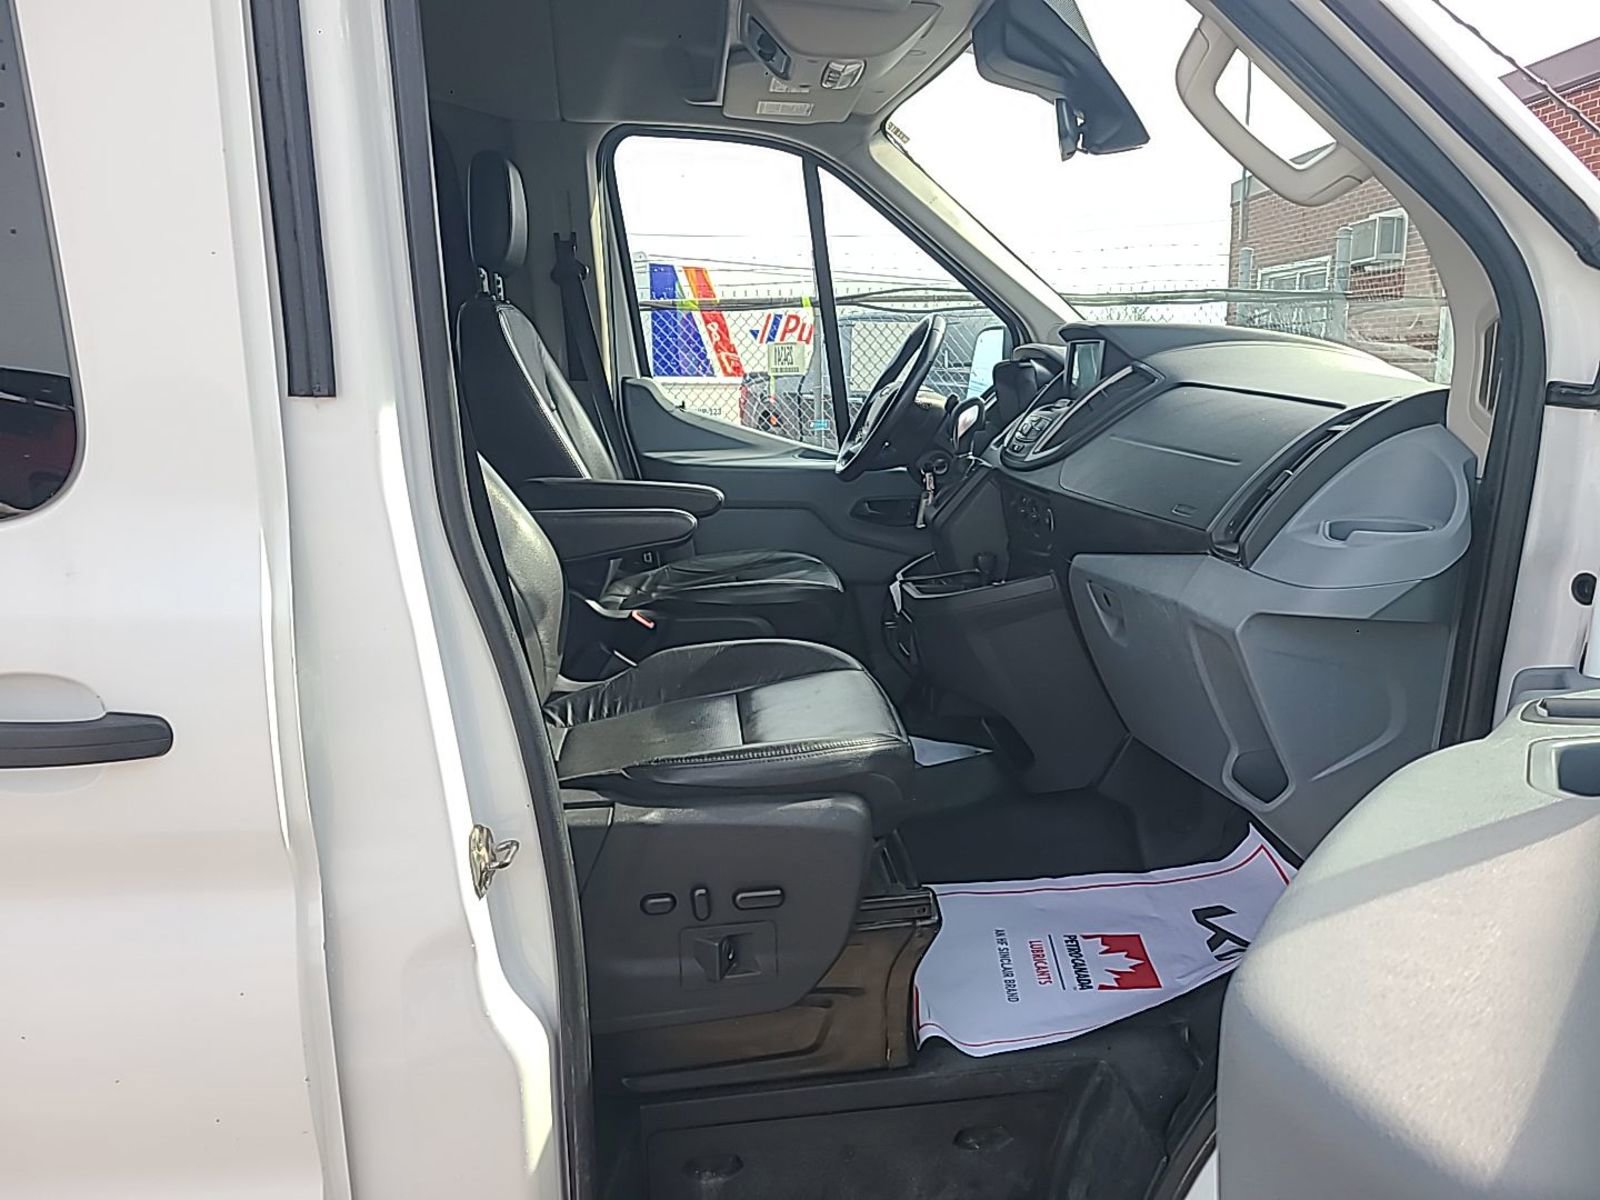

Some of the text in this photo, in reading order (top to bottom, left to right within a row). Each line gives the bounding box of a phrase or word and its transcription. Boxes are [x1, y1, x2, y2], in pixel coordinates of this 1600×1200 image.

[999, 948, 1014, 980] SINCLAIR
[1029, 940, 1052, 985] LUBRICANTS
[1003, 979, 1020, 1003] BRAND
